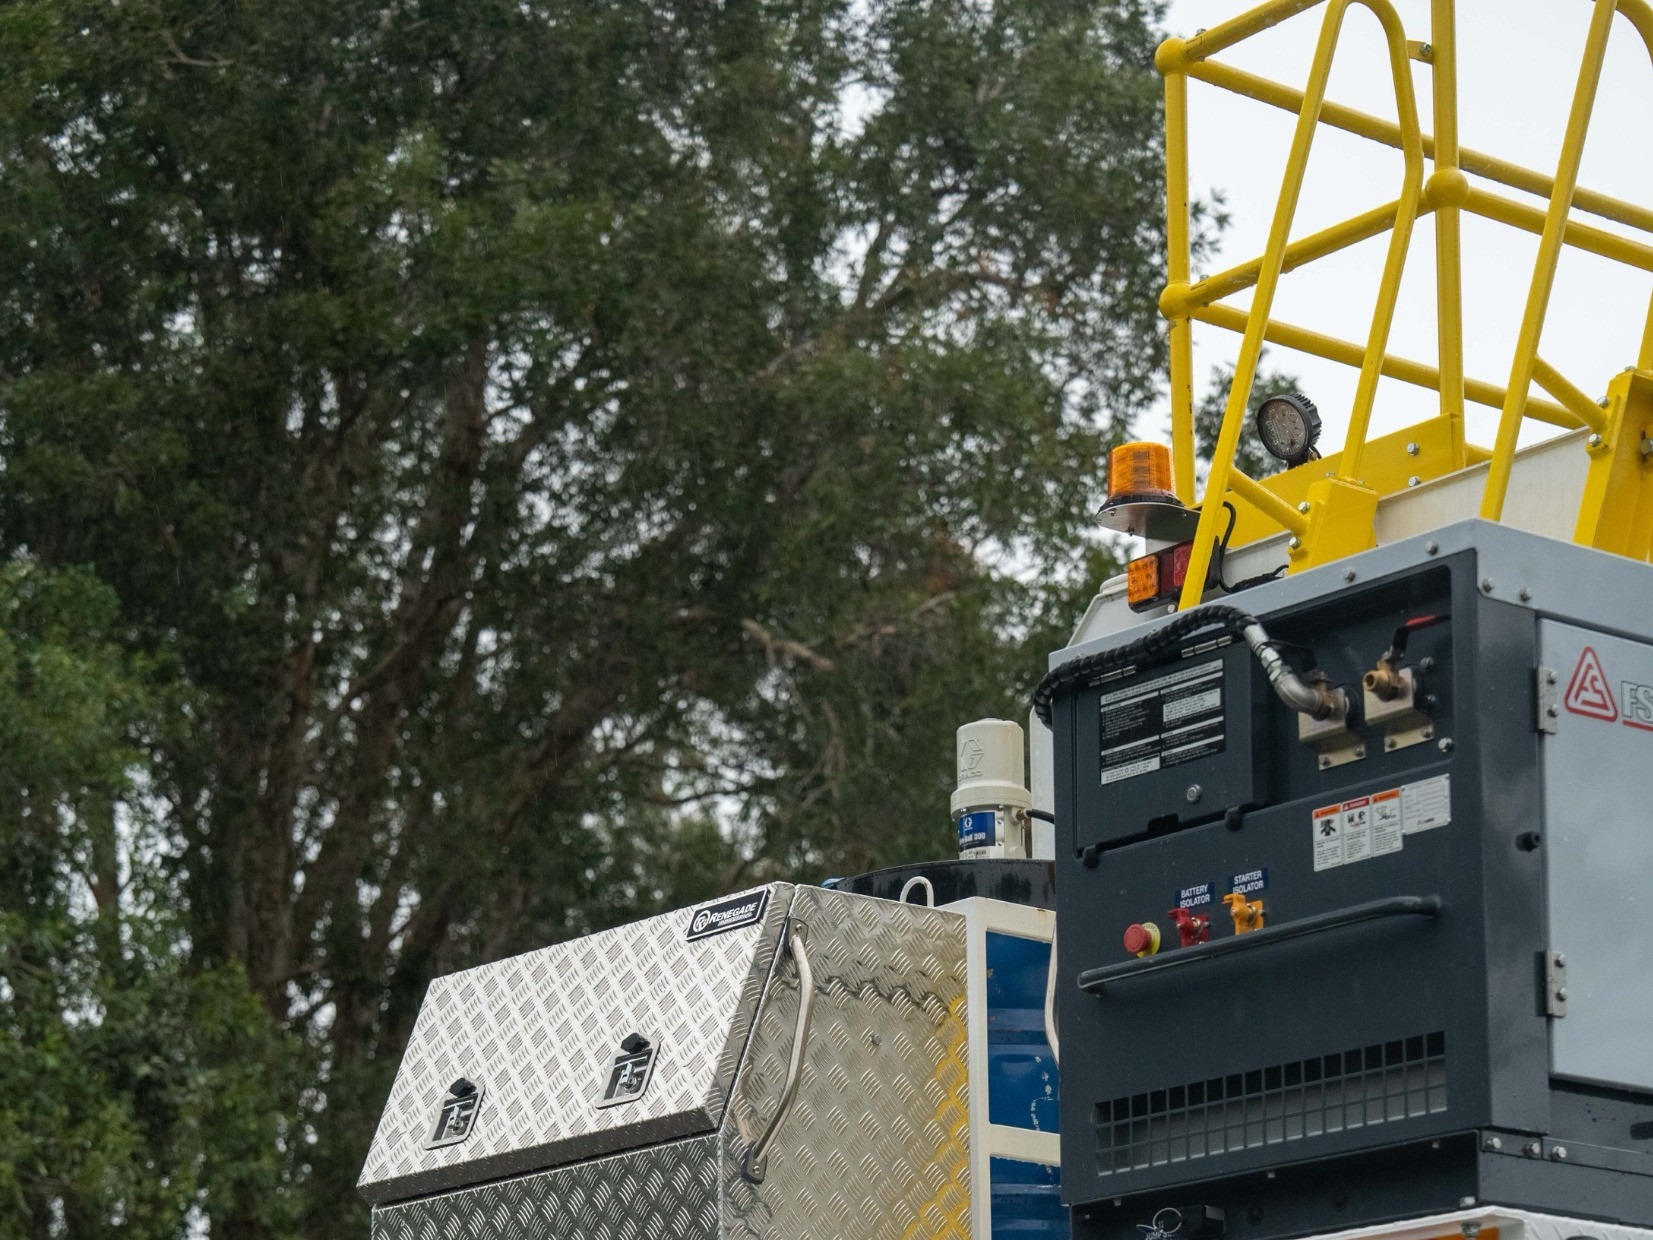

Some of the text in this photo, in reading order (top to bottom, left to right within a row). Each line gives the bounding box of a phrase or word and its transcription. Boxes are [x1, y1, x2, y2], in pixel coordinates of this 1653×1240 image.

[1233, 870, 1262, 885] STARTER
[1181, 884, 1209, 898] BATTERY
[1232, 880, 1264, 894] ISOLATOR
[1180, 894, 1211, 908] ISOLATOR
[708, 902, 758, 924] RENEGADE
